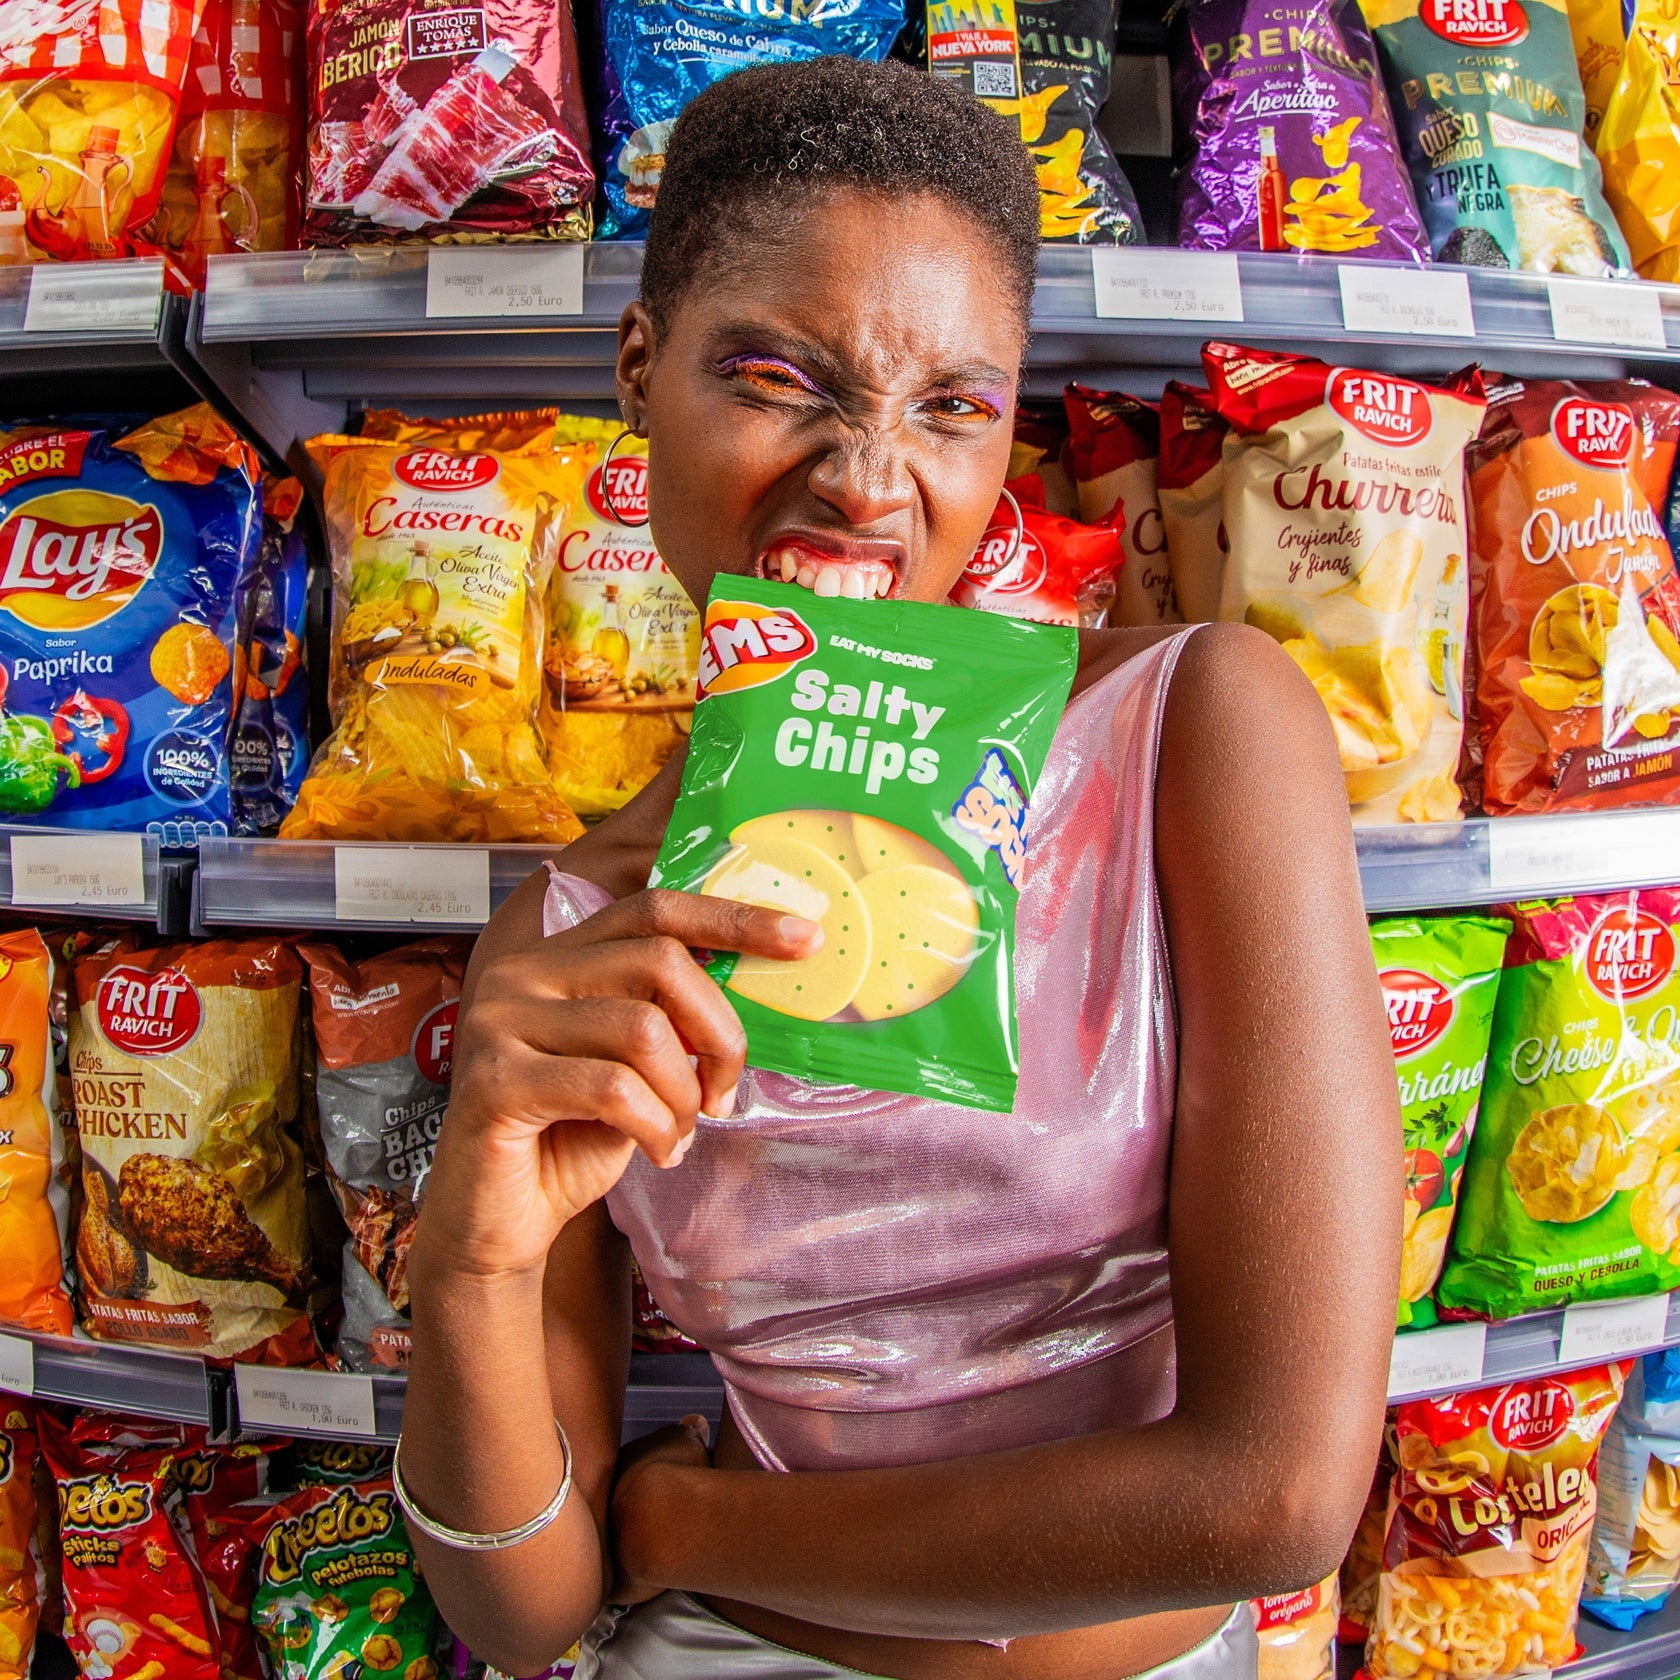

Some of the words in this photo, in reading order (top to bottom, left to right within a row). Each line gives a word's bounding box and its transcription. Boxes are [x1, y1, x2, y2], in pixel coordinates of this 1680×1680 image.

[1435, 0, 1505, 20] FRIT
[349, 18, 400, 48] JAMÓN
[417, 15, 478, 32] ENRIQUE
[423, 26, 472, 42] TOMÁS
[1446, 20, 1507, 34] RAVICH
[642, 23, 673, 36] Sabor
[674, 18, 727, 45] Queso
[729, 34, 743, 48] de
[745, 35, 792, 58] Cabra
[652, 41, 661, 56] y
[662, 37, 708, 53] Cebolla
[931, 41, 977, 59] NUEVA
[1261, 79, 1292, 92] Sabor
[1401, 71, 1568, 118] PREMIUM
[1235, 88, 1340, 118] Aperitivo
[1425, 106, 1455, 125] Sabor
[1418, 112, 1480, 159] QUESO
[1432, 139, 1485, 168] CURADO
[1434, 163, 1502, 198] TRUFA
[1457, 192, 1505, 214] NEGRA
[538, 296, 563, 306] Euro
[1201, 301, 1225, 312] Euro
[1437, 317, 1458, 327] Euro
[1342, 377, 1419, 416] FRIT
[1354, 405, 1413, 433] RAVICH
[1567, 407, 1631, 442] FRIT
[47, 434, 67, 447] EL
[406, 452, 488, 472] FRIT
[1343, 452, 1384, 471] Patatas
[1385, 458, 1412, 477] fritas
[412, 469, 476, 482] RAVICH
[411, 496, 475, 511] Auténticas
[1536, 482, 1578, 502] CHIPS
[362, 497, 524, 544] Caseras
[1277, 521, 1364, 559] Crujientes
[0, 517, 153, 601] Lay's
[459, 545, 504, 563] Aceite
[1605, 547, 1661, 584] Jamón
[440, 557, 480, 576] Oliva
[481, 563, 521, 592] Virgen
[1288, 559, 1303, 584] y
[1306, 552, 1353, 580] finas
[462, 576, 507, 601] Extra
[643, 586, 683, 602] Aceite
[45, 638, 77, 648] Sabor
[829, 634, 857, 651] EAT
[856, 643, 882, 659] MY
[880, 650, 934, 671] SOCKS
[13, 650, 114, 686] Paprika
[790, 668, 946, 741] Salty
[156, 748, 210, 768] 100%
[774, 716, 940, 795] Chips
[1586, 751, 1634, 772] PATATAS
[152, 767, 214, 779] INGREDIENTES
[161, 777, 173, 786] de
[1587, 768, 1621, 789] SABOR
[1622, 767, 1631, 779] A
[1632, 753, 1673, 778] JAMÓN
[106, 885, 128, 896] Euro
[447, 902, 471, 914] Euro
[1595, 928, 1662, 963] FRIT
[1597, 962, 1653, 981] RAVICH
[107, 979, 188, 1019] FRIT
[110, 1015, 174, 1038] RAVICH
[1563, 1017, 1599, 1035] CHIPS
[76, 1050, 104, 1078] Chips
[1511, 1036, 1616, 1086] Cheese
[73, 1078, 146, 1109] ROAST
[384, 1095, 437, 1127] Chips
[1535, 1262, 1576, 1277] PATATAS
[1578, 1253, 1610, 1270] FRITAS
[1612, 1244, 1642, 1262] SABOR
[1533, 1275, 1574, 1293] QUESO
[1578, 1271, 1586, 1283] Y
[1589, 1258, 1640, 1281] CEBOLLA
[124, 1307, 160, 1324] FRITAS
[161, 1312, 200, 1326] SABOR
[105, 1320, 143, 1337] POLLO
[145, 1326, 190, 1341] ASADO
[1, 1373, 20, 1386] Euro
[1449, 1369, 1469, 1379] Euro
[1502, 1387, 1562, 1430] FRIT
[336, 1415, 359, 1426] Euro
[1508, 1418, 1555, 1442] RAVICH
[311, 1552, 408, 1586] pelotazos
[328, 1565, 396, 1587] futebolas
[1269, 1596, 1313, 1622] orégano
